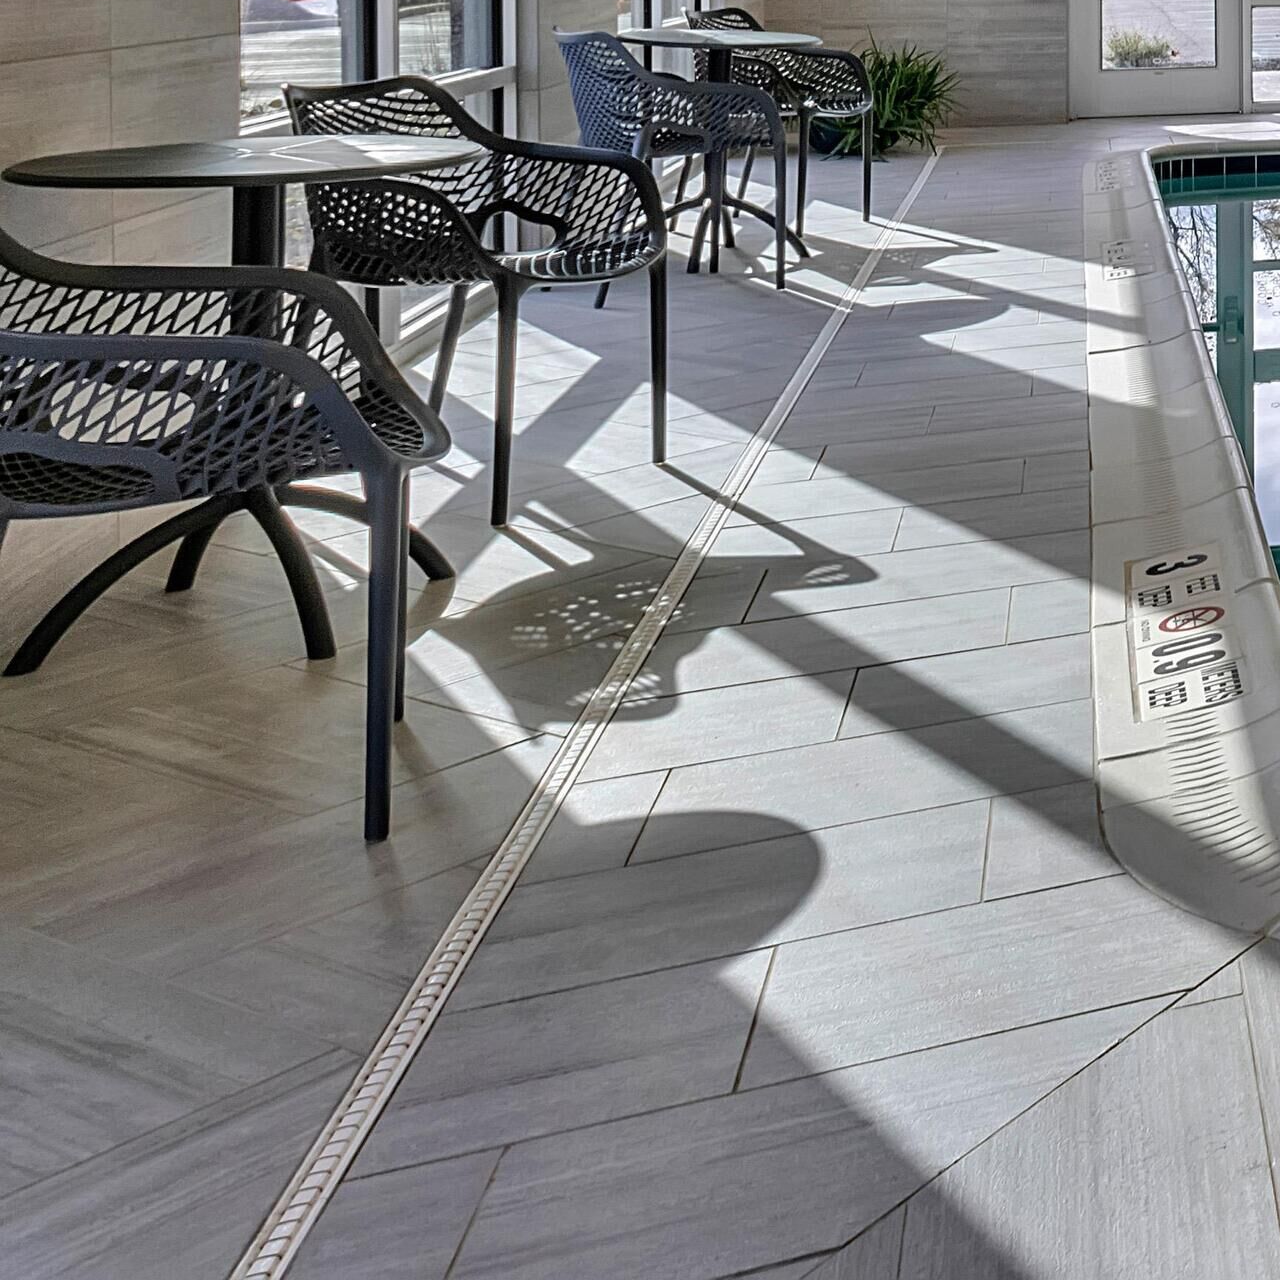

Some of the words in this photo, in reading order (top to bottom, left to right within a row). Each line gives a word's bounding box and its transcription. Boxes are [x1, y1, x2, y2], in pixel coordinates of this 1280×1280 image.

[1145, 554, 1208, 576] 3
[1152, 632, 1226, 675] 0.9
[1148, 681, 1188, 710] DEEP
[1201, 661, 1244, 704] METERS
